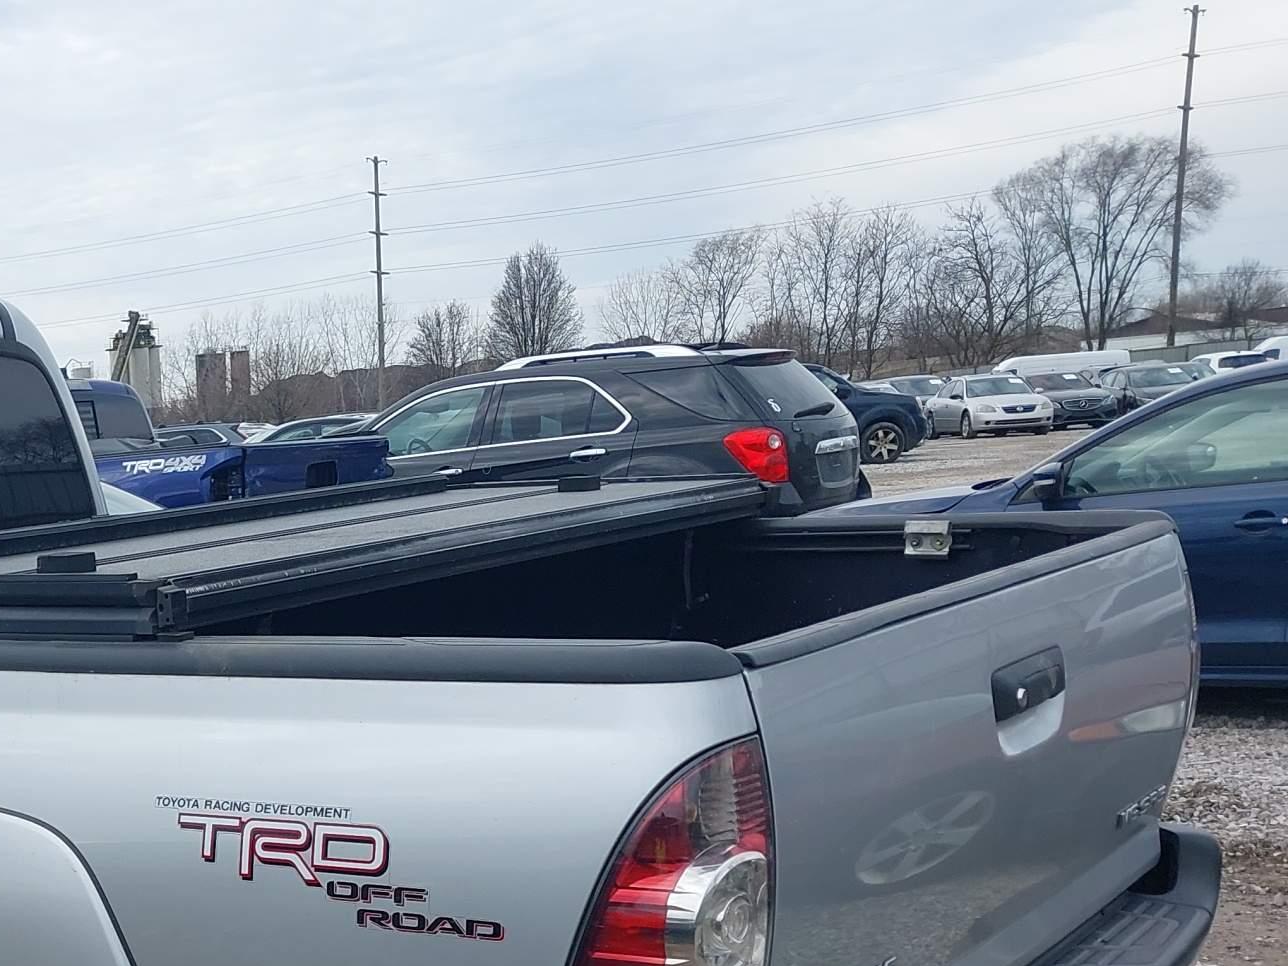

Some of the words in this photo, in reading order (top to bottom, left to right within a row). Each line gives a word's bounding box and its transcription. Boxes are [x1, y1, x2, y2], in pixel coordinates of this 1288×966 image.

[122, 458, 165, 475] TRD
[162, 463, 203, 474] SPORT
[156, 796, 199, 810] TOYOTA
[204, 799, 251, 813] RACING
[254, 803, 351, 819] DEVELOPMENT
[178, 812, 390, 887] TRD
[326, 880, 428, 906] OFF
[357, 908, 505, 941] ROAD
